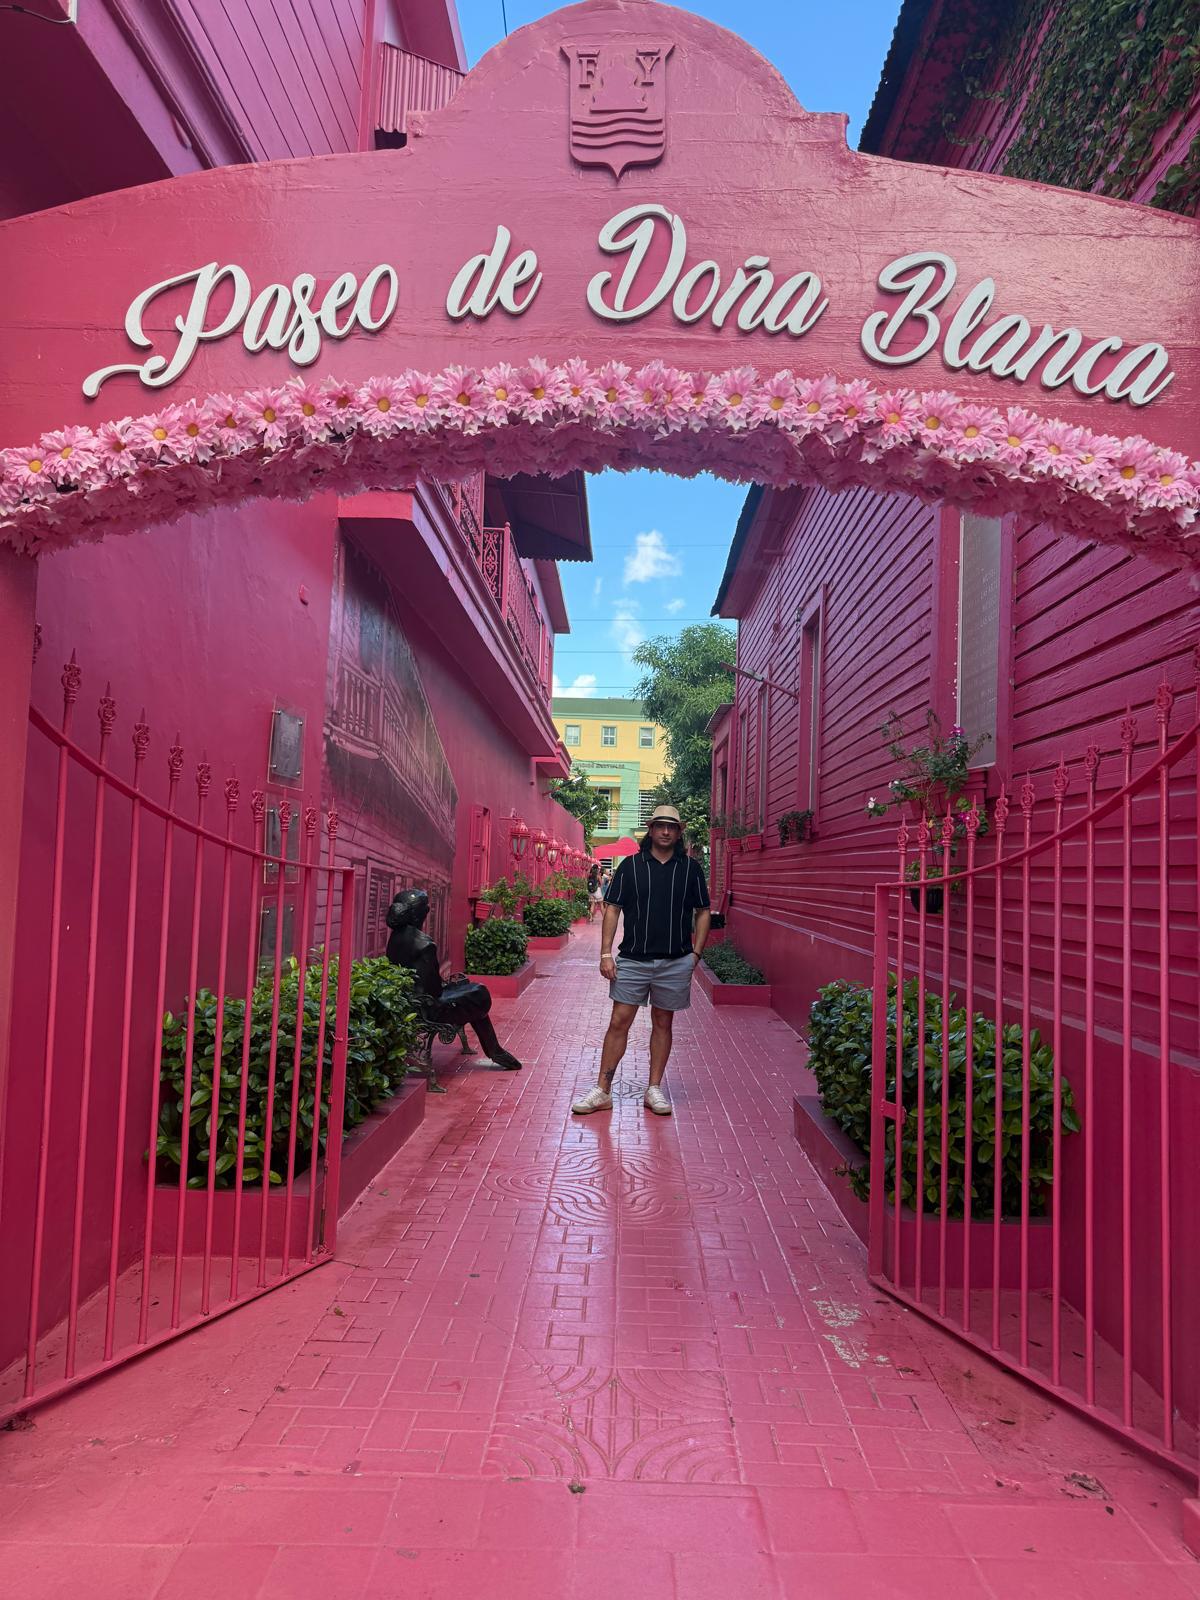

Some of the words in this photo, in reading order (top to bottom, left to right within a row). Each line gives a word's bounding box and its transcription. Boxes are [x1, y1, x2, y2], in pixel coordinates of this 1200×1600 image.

[578, 56, 598, 89] F
[635, 55, 661, 87] Y
[82, 261, 399, 398] Paseo
[445, 225, 543, 318] de
[586, 203, 830, 336] Doña
[860, 251, 1175, 406] Blanca
